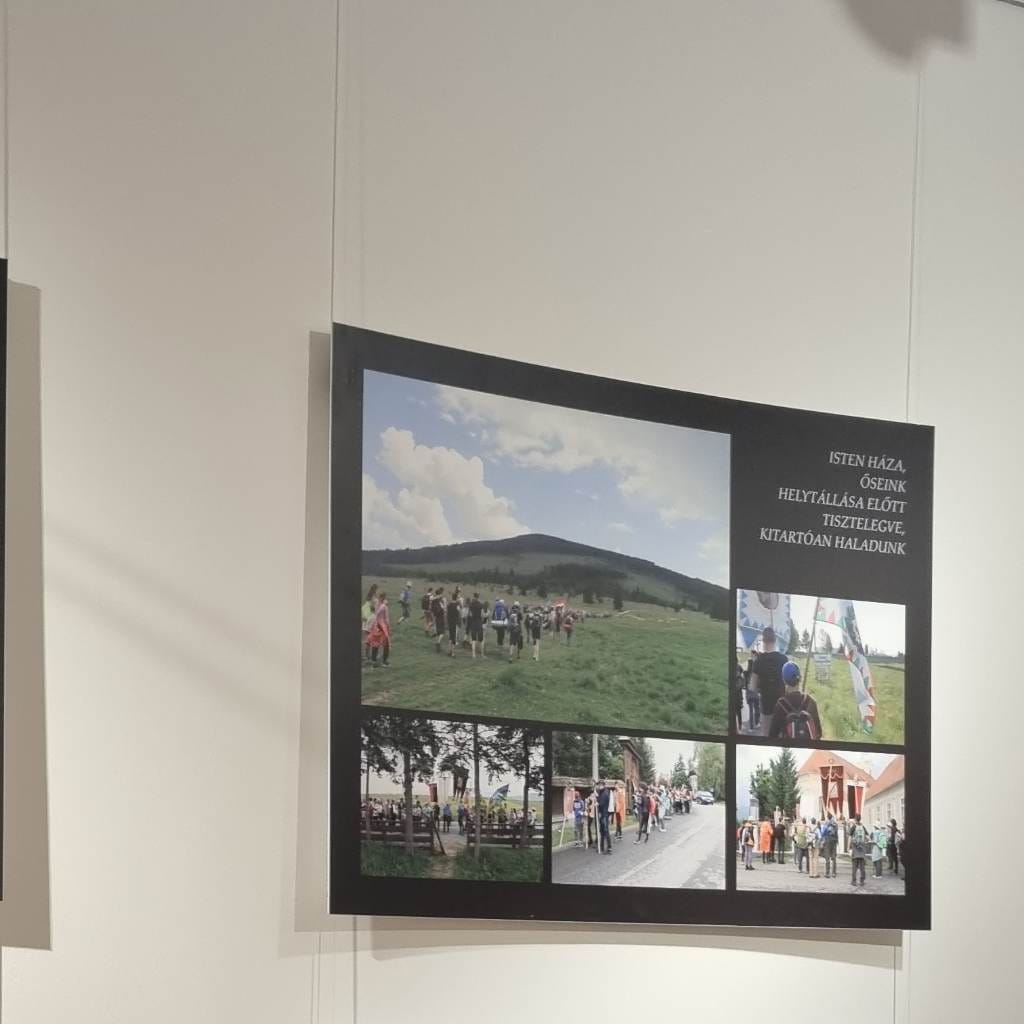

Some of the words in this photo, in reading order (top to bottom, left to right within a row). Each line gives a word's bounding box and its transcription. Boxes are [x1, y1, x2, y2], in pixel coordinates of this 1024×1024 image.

[829, 451, 865, 467] ISTEN
[868, 454, 907, 473] HÁZA,
[860, 473, 907, 493] ŐSEINK
[778, 487, 864, 509] HELYTÁLLÁSA
[867, 496, 907, 513] ELŐTT
[823, 513, 906, 536] TISZTELEGVE,
[760, 527, 832, 547] KITARTÓAN
[834, 536, 907, 555] HALADUNK
